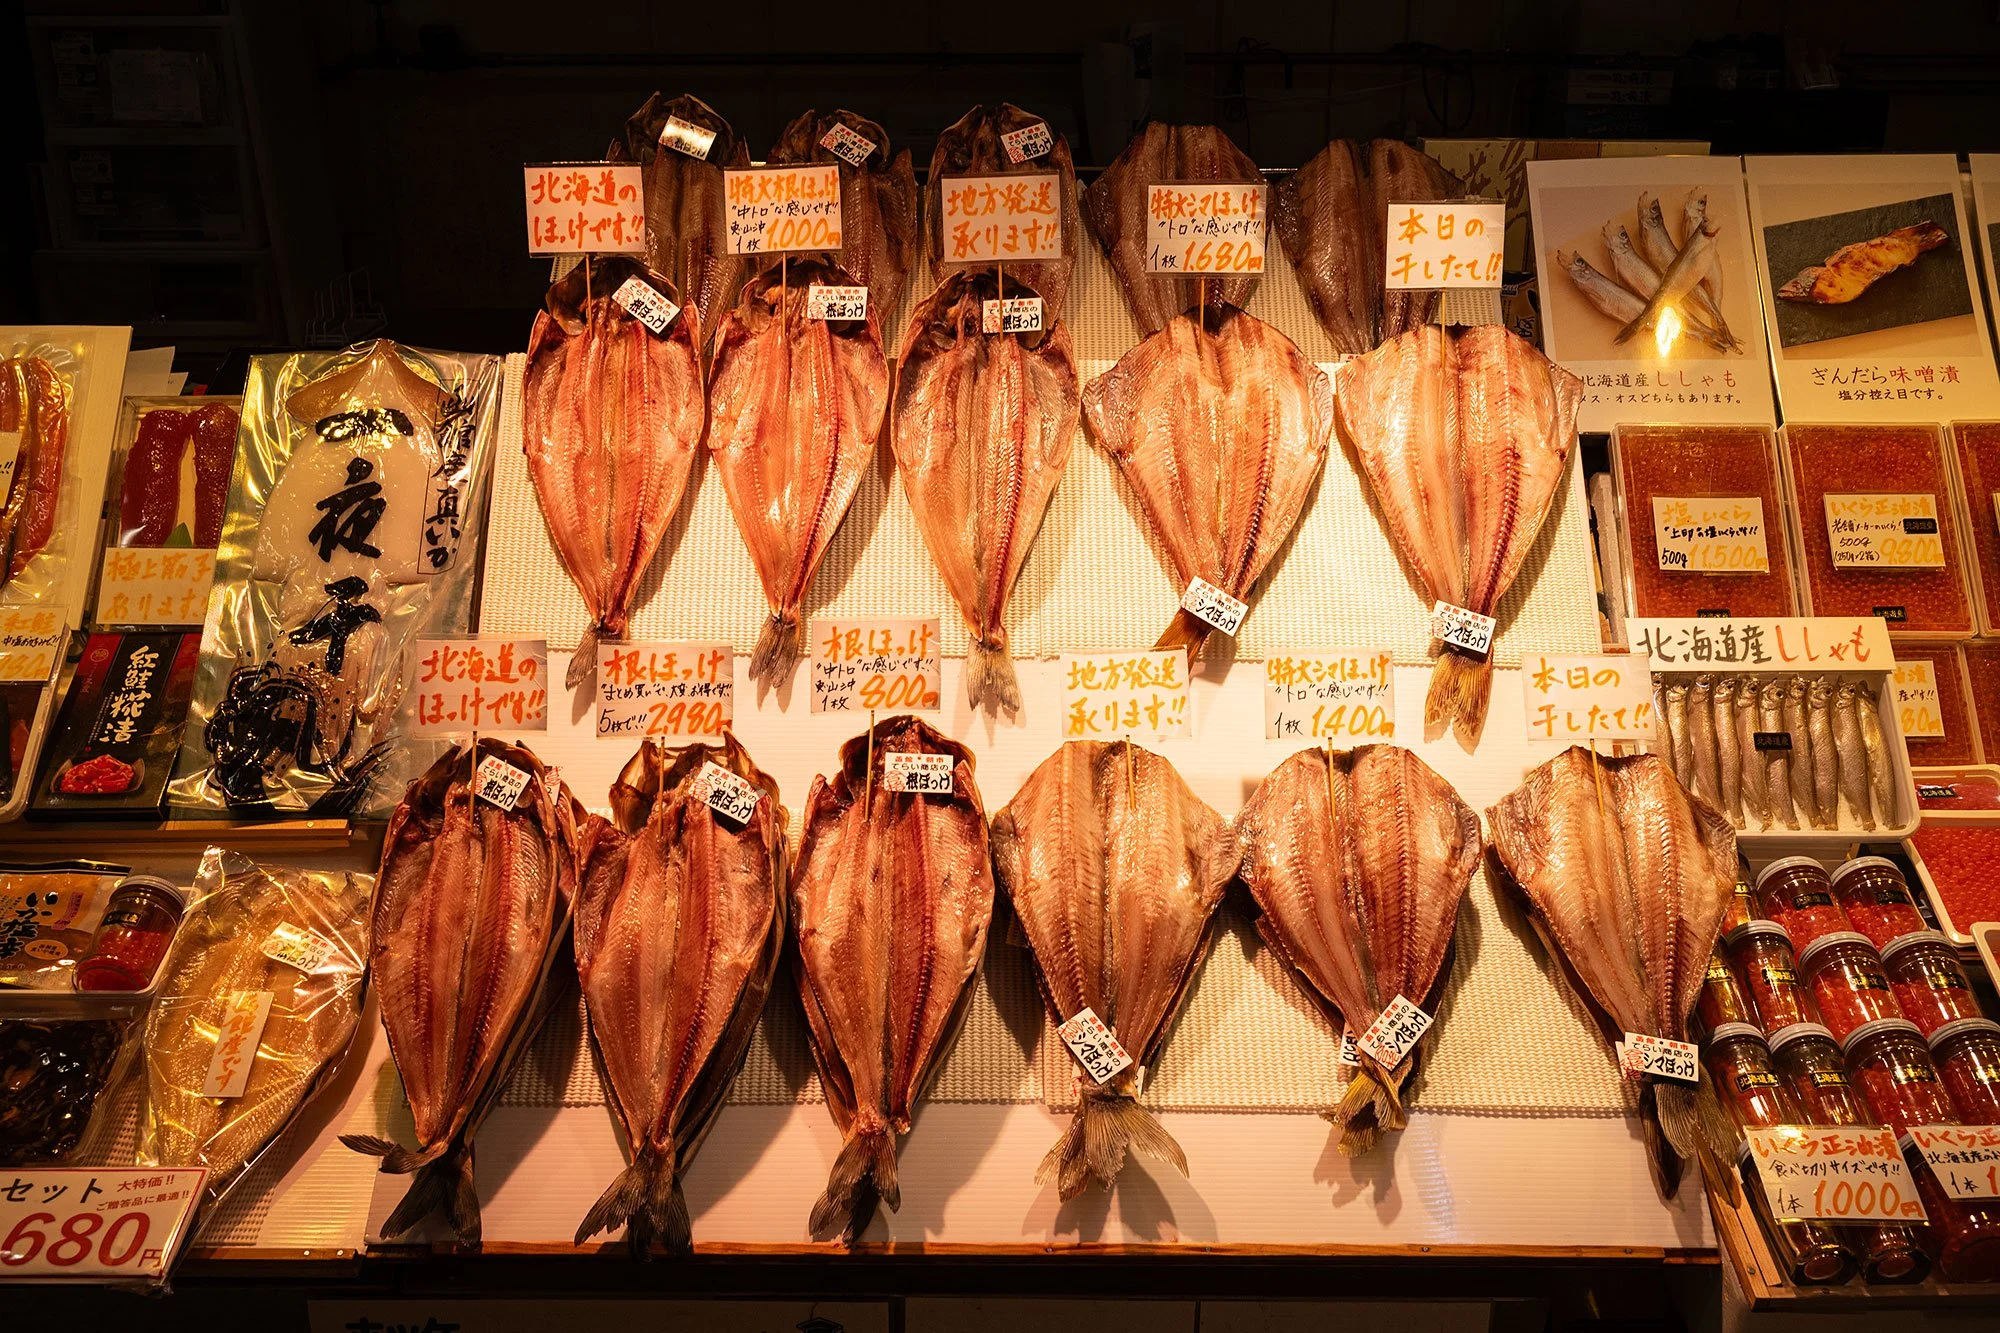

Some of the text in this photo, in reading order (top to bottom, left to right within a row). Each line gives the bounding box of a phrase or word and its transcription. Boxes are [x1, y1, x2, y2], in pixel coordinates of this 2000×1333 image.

[531, 169, 637, 206] 北海道の
[729, 169, 839, 205] 特大根ほっけ
[946, 181, 1057, 218] 地方発送
[1151, 188, 1260, 220] 特大シマほっけ
[534, 211, 644, 249] ほっけです!!
[952, 218, 1058, 259] 承ります!!
[1397, 207, 1485, 245] 本日の
[736, 235, 761, 254] 1枚
[1150, 243, 1178, 271] 1枚
[1391, 251, 1503, 285] 干したて!!
[1811, 365, 1961, 386] ぎんだら味噌漬
[1838, 388, 1944, 401] 塩分控え目です。
[1662, 501, 1752, 528] 塩いくら
[1830, 496, 1932, 518] いくら正油漬
[107, 552, 211, 582] 極上筋子
[1661, 548, 1689, 569] 500g
[822, 623, 933, 664] 根ほっけ
[1637, 623, 1872, 666] 北海道産ししゃも
[421, 642, 539, 685] 北海道の
[604, 648, 725, 686] 根ほっけ
[1067, 654, 1182, 691] 地方発送
[1267, 654, 1390, 686] 特大シマほっけ
[1531, 656, 1621, 693] 本日の
[418, 686, 546, 727] ほっけです!!
[822, 674, 939, 712] 1枚 800円
[1068, 697, 1187, 736] 承ります!!
[1274, 712, 1303, 738] 1枚
[1531, 702, 1651, 737] 干したて!!
[892, 763, 949, 771] てらい商店の
[1753, 1132, 1902, 1162] いくら正油漬
[1769, 1159, 1901, 1178] 食べ切りサイズです!!
[1, 1174, 175, 1203] セット 大特価!!
[97, 1190, 190, 1212] ご贈答品に最適!!
[1777, 1188, 1804, 1214] 1本
